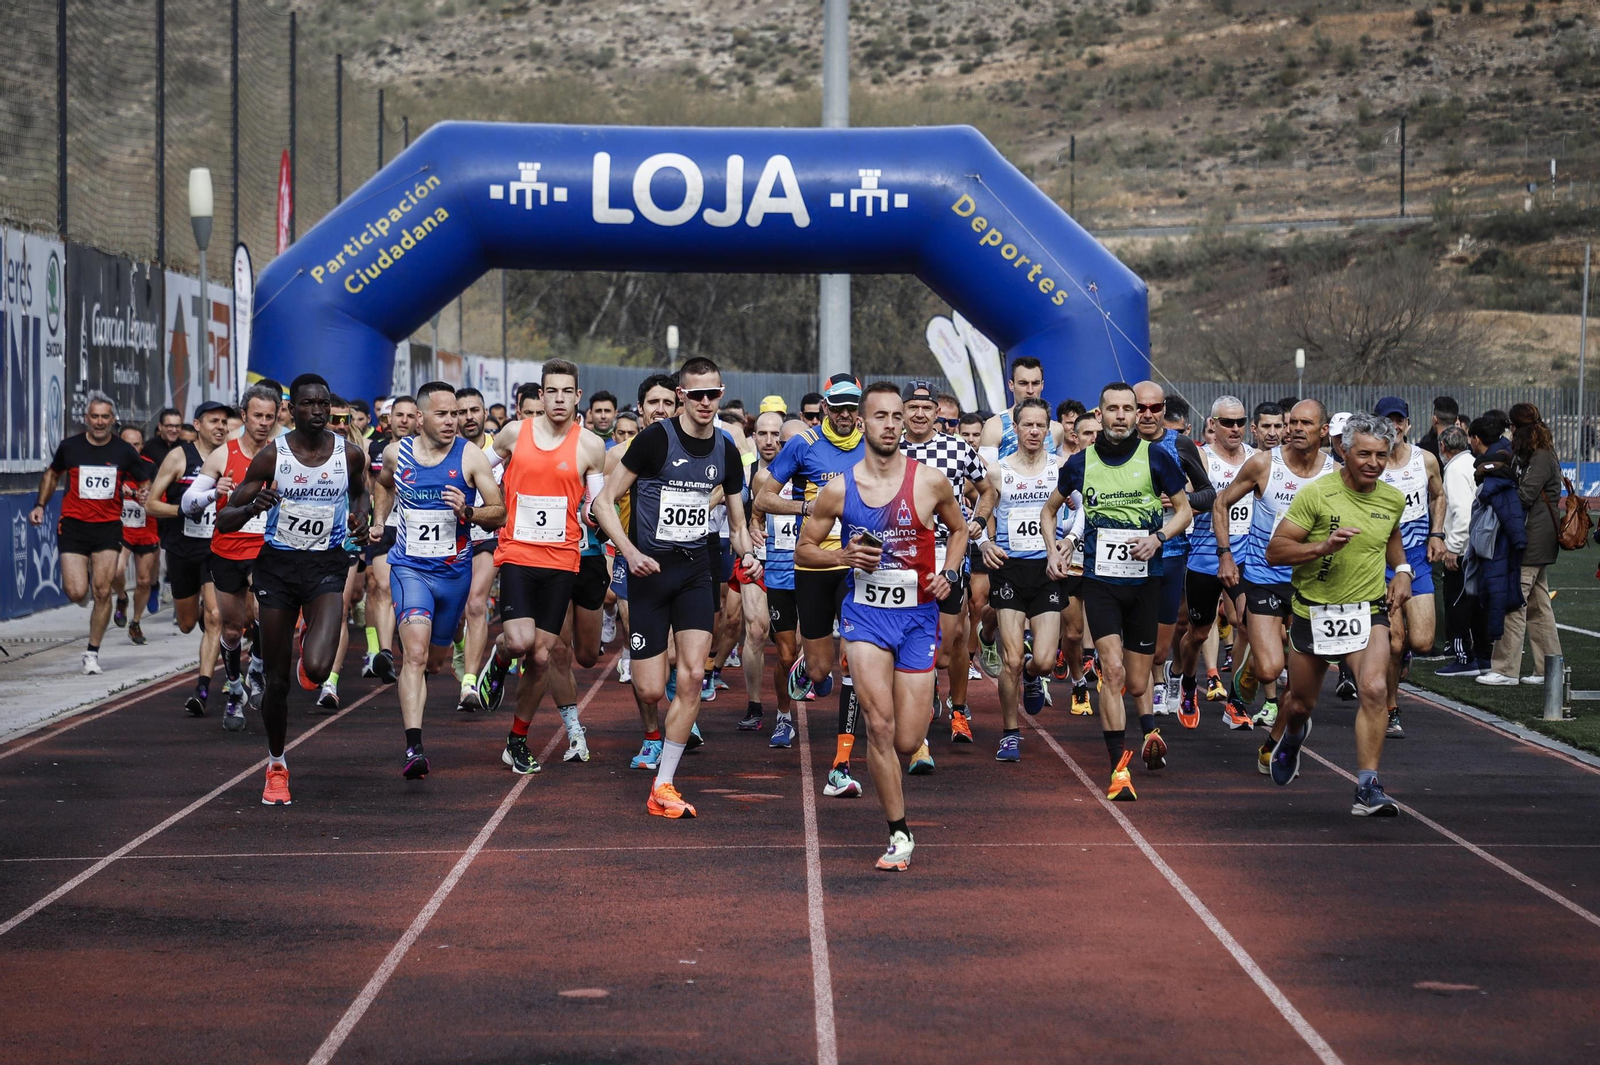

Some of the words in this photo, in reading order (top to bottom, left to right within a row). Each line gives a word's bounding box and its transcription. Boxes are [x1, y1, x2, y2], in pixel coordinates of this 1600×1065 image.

[592, 151, 811, 228] LOJA
[310, 175, 441, 284] Participación
[344, 207, 449, 294] Ciudadana
[951, 193, 1068, 306] Deportes
[86, 476, 110, 489] 676
[684, 481, 713, 489] ATLETISMO
[283, 488, 340, 497] MARACENA
[1009, 491, 1053, 501] MARACEN
[1100, 491, 1142, 500] Certificado
[535, 510, 547, 527] 3
[663, 507, 706, 527] 3058
[1230, 506, 1249, 521] 69
[287, 515, 324, 536] 740
[418, 524, 440, 541] 21
[864, 583, 906, 605] 579
[1323, 617, 1362, 638] 320
